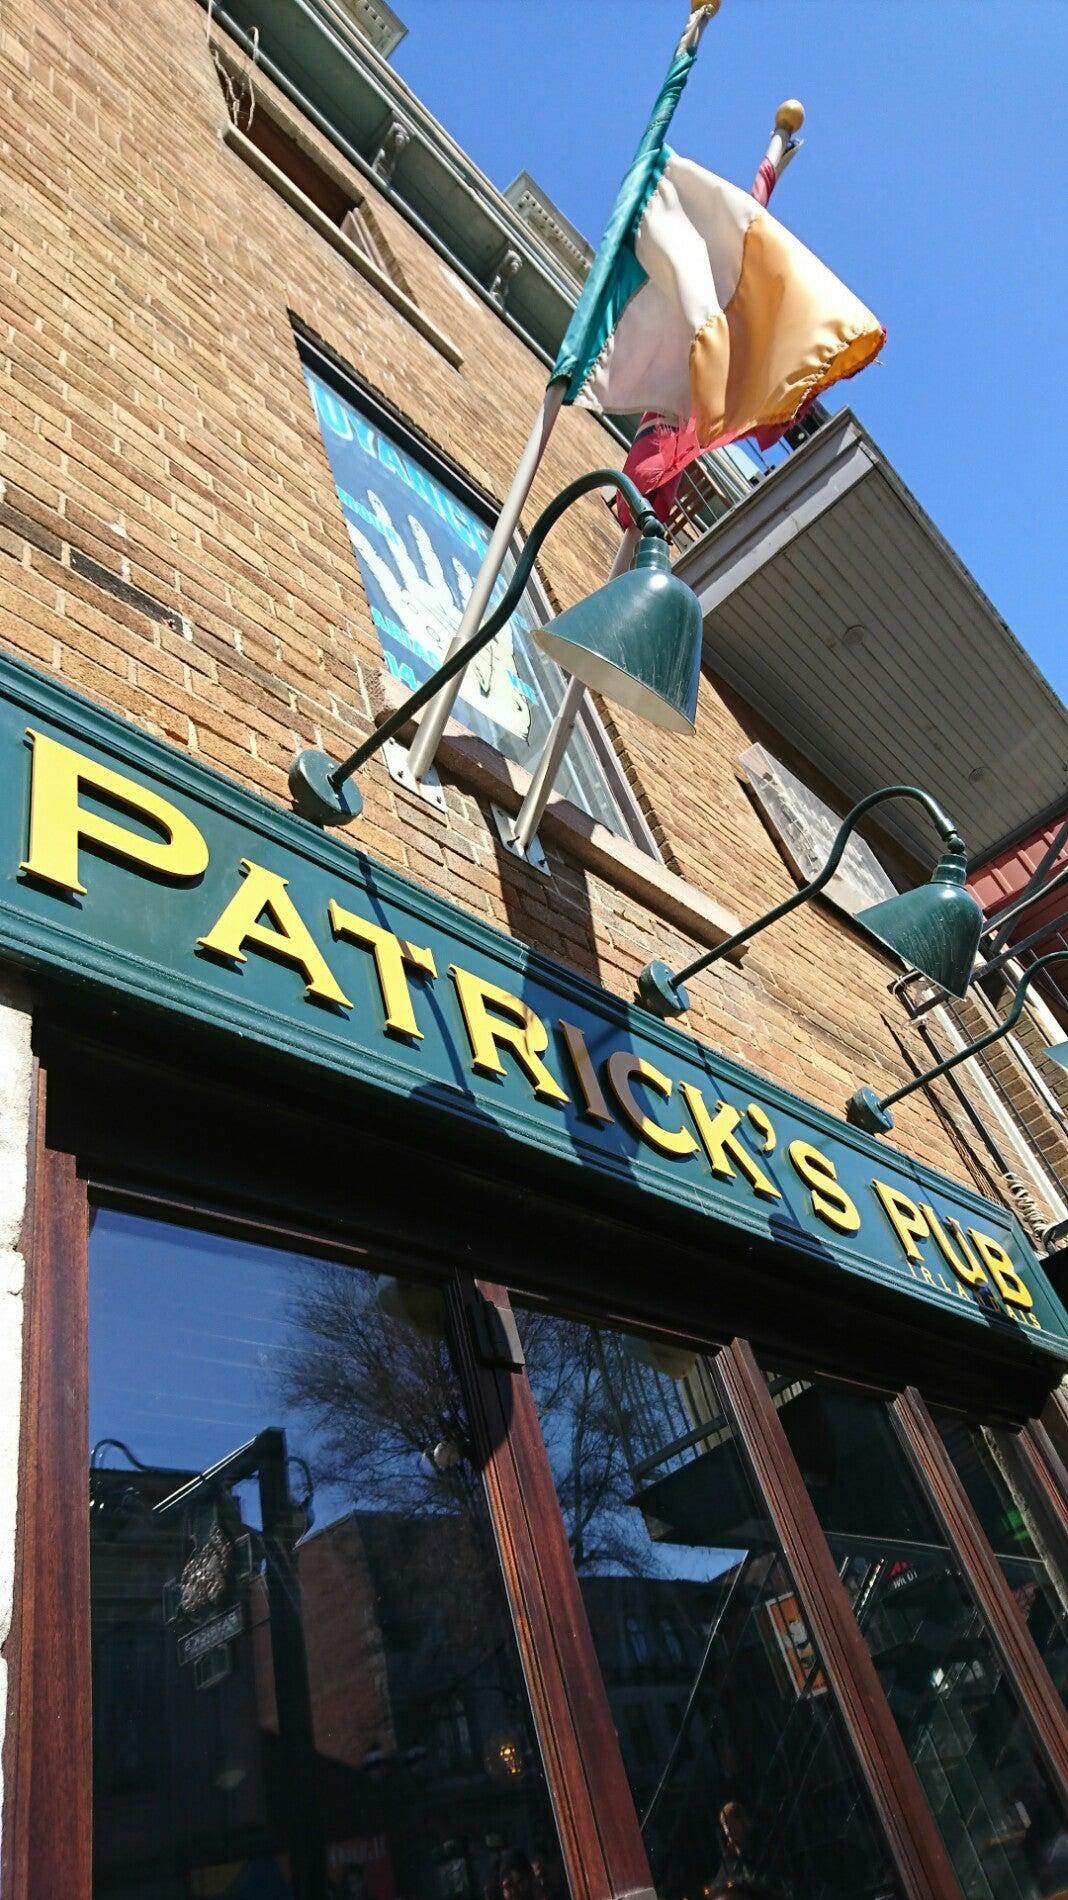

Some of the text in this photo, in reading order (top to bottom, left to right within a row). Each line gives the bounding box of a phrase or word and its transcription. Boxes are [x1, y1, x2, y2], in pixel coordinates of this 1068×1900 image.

[307, 376, 489, 559] OYANCE
[18, 728, 1033, 1309] PATRICK'S PUB
